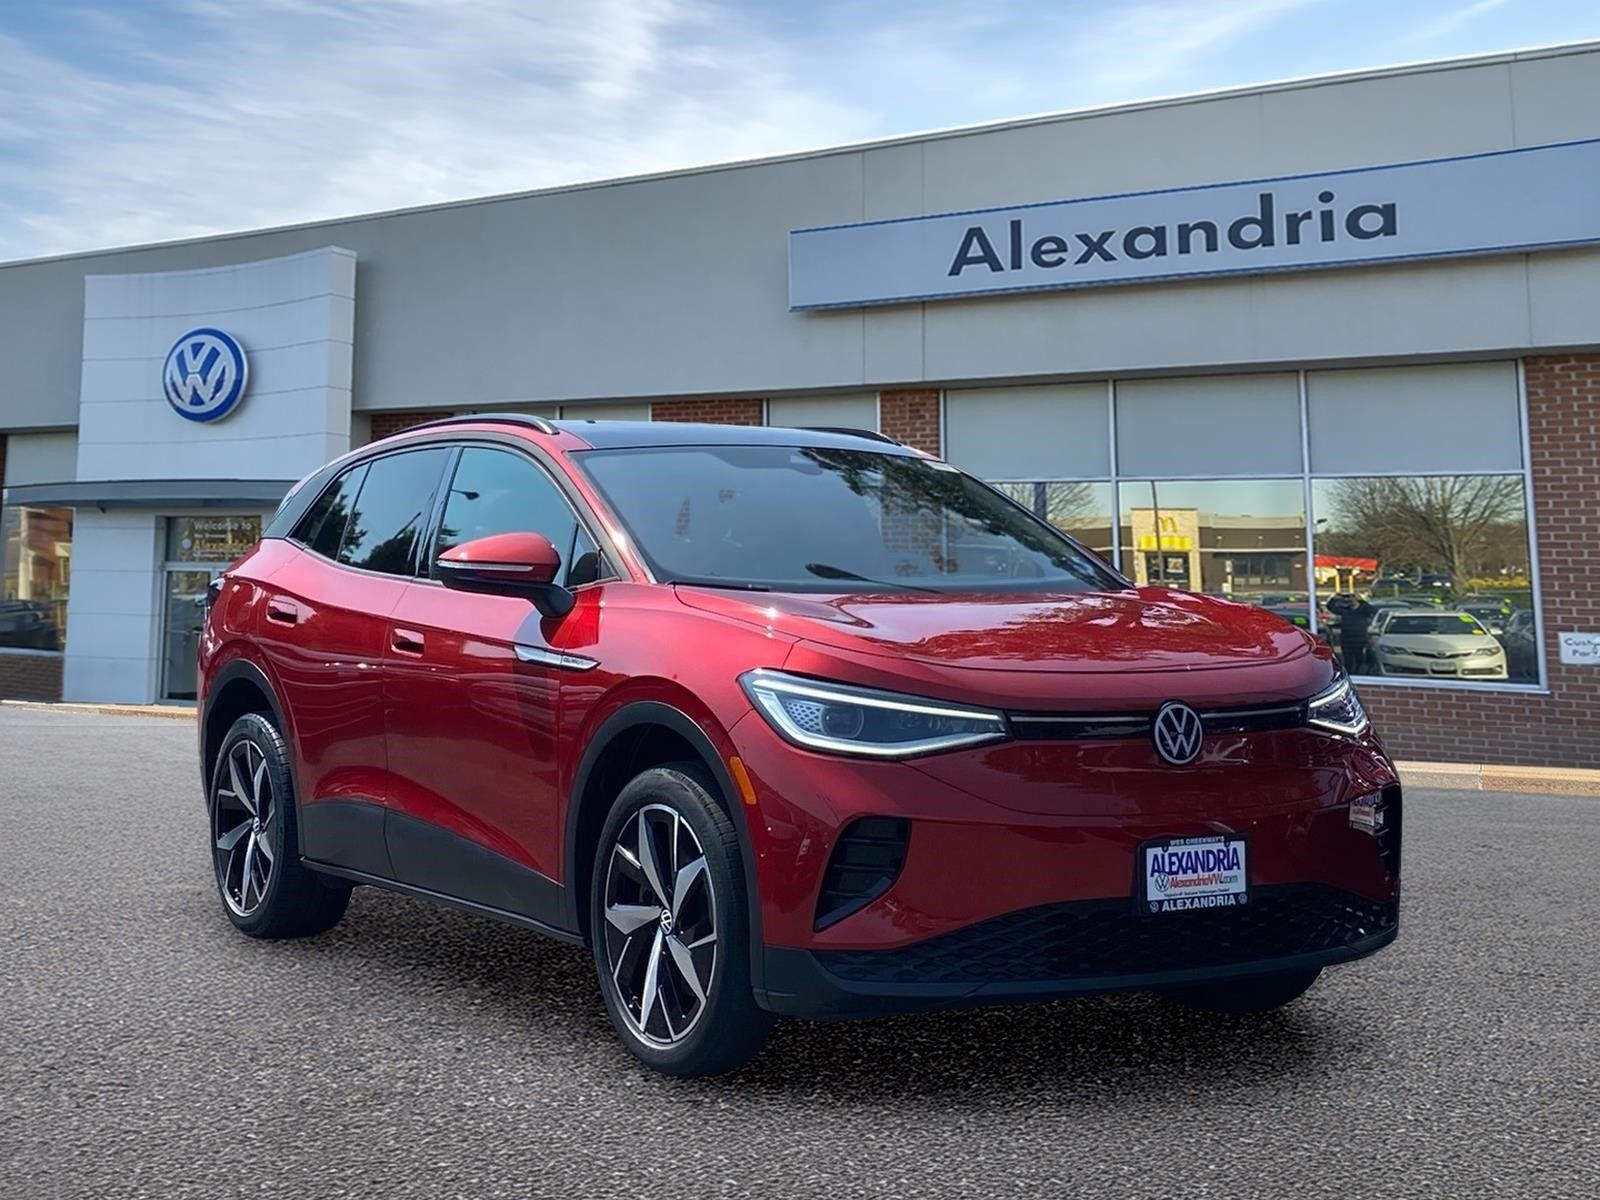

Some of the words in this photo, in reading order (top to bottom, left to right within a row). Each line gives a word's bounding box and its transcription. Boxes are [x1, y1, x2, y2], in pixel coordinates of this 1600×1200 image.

[947, 191, 1397, 276] Alexandria
[163, 328, 246, 422] VW
[1155, 704, 1202, 764] VW
[1150, 847, 1240, 877] ALEXANDRIA
[1162, 895, 1236, 912] ALEXANDRIA
